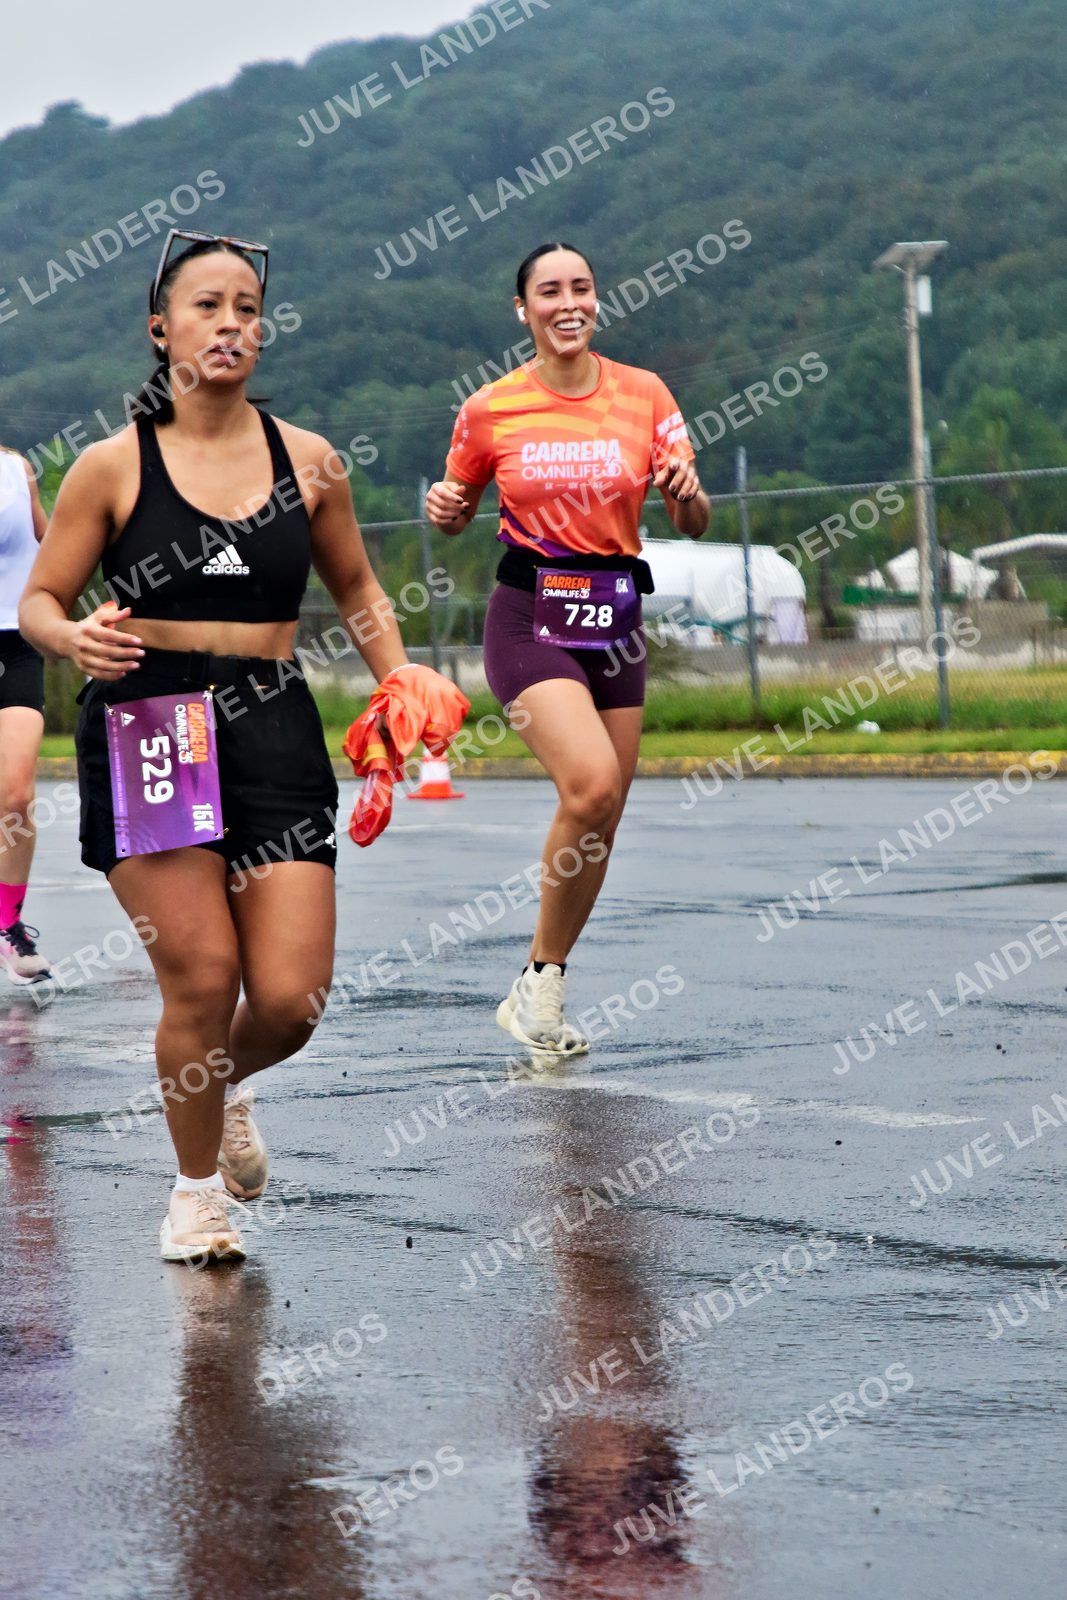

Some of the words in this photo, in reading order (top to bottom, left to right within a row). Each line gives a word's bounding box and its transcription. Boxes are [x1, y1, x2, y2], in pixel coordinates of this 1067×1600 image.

[521, 439, 621, 463] CARRERA
[521, 464, 601, 481] OMNILIFE
[202, 562, 250, 575] adidas
[542, 588, 580, 599] OMNILIFE
[543, 575, 592, 590] CARRERA
[564, 603, 614, 628] 728
[174, 703, 189, 752] OMNILIFE
[187, 703, 209, 764] CARRERA
[139, 735, 175, 805] 529
[192, 803, 215, 832] 15K
